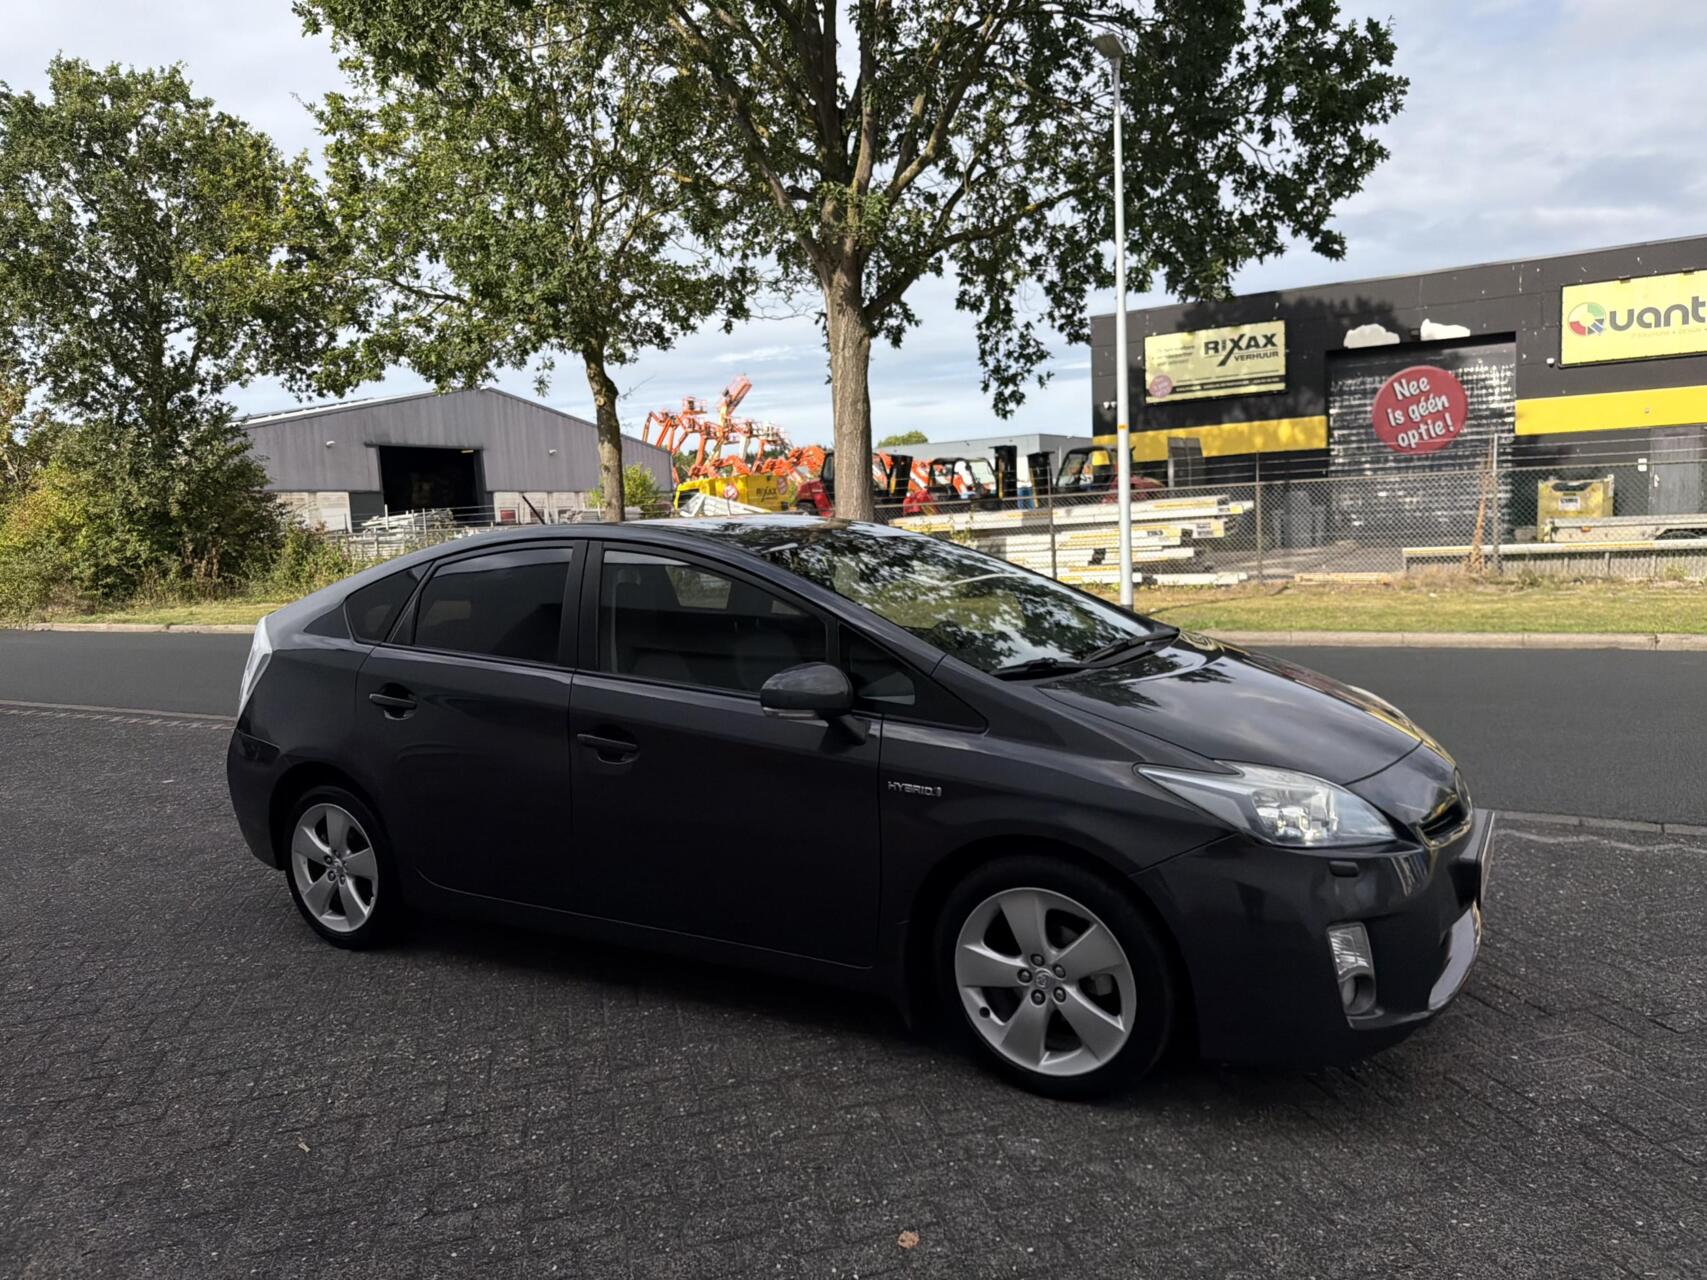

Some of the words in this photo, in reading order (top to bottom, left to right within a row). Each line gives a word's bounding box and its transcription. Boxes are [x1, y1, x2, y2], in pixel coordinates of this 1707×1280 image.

[1234, 350, 1279, 362] VERHUUR
[1392, 377, 1430, 400] Nee
[1387, 408, 1405, 426] is
[1408, 393, 1450, 422] géén
[887, 781, 935, 796] HYBRID
